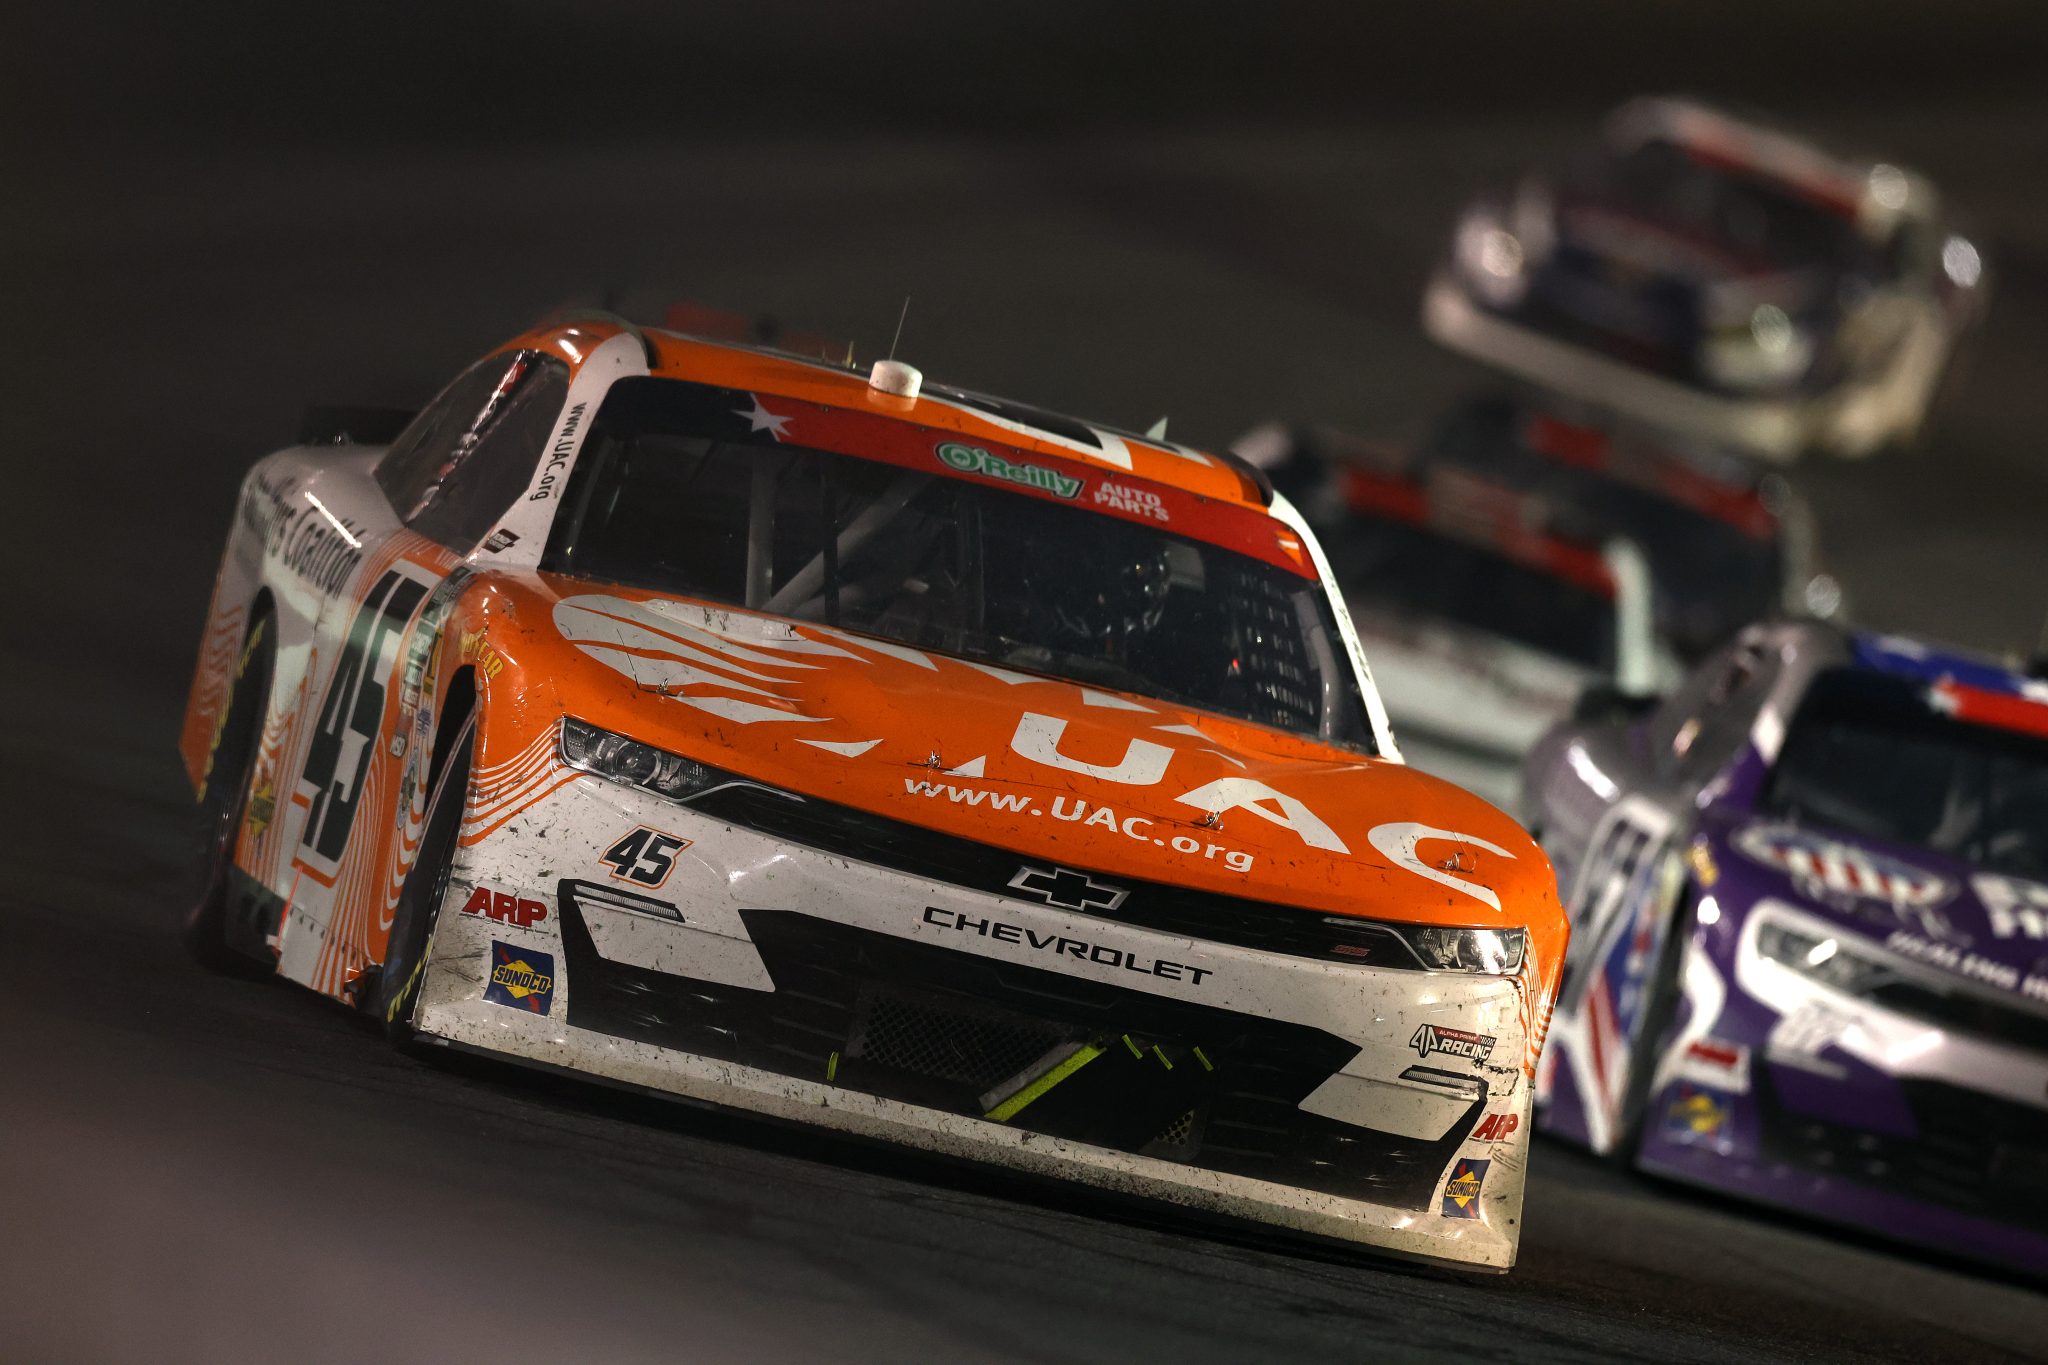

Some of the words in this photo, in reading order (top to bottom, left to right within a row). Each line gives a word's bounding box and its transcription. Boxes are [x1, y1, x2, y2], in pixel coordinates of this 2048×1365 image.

[530, 402, 587, 502] www.UAC.org
[937, 443, 1084, 499] O'Reilly
[1094, 491, 1170, 522] PARTS
[1100, 482, 1162, 508] AUTO
[301, 569, 430, 863] 45
[903, 776, 1255, 874] www.UAC.org
[1010, 710, 1518, 912] UAC
[602, 828, 686, 886] 45
[462, 885, 548, 928] ARP
[922, 905, 1214, 986] CHEVROLET
[494, 965, 550, 994] SUNOCO
[1439, 1029, 1458, 1038] ALPHA
[1439, 1038, 1492, 1060] RACING
[1447, 1179, 1479, 1199] SUNOCO
